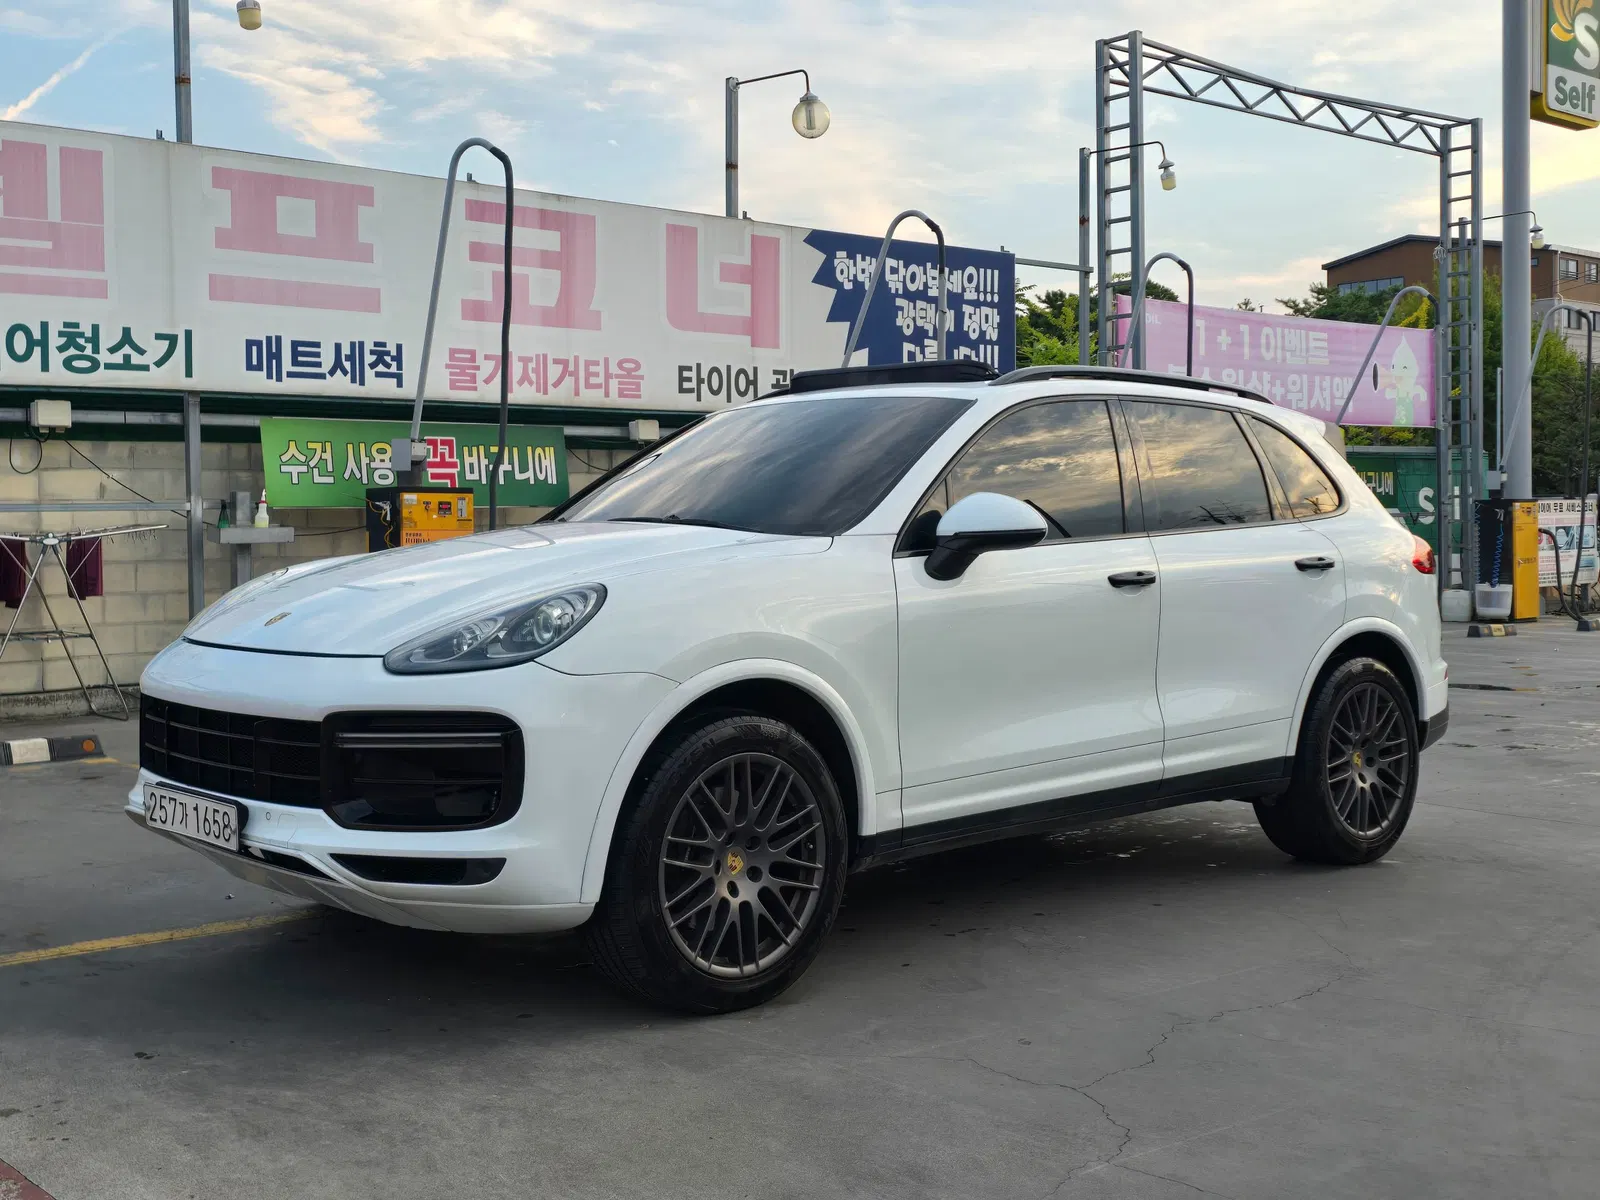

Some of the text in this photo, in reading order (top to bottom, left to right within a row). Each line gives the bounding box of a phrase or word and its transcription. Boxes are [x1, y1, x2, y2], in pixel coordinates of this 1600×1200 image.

[1554, 75, 1595, 114] Self
[834, 251, 999, 303] 한번 닦아보세요!!!
[895, 298, 1000, 341] 광택이 정말
[1260, 326, 1330, 365] 이벤트
[0, 320, 193, 378] 어청소기
[245, 334, 404, 388] 매트세척
[445, 347, 644, 399] 물기제거타올
[678, 362, 758, 402] 타이어
[279, 436, 557, 488] 수건 사용 꼭 바구니에
